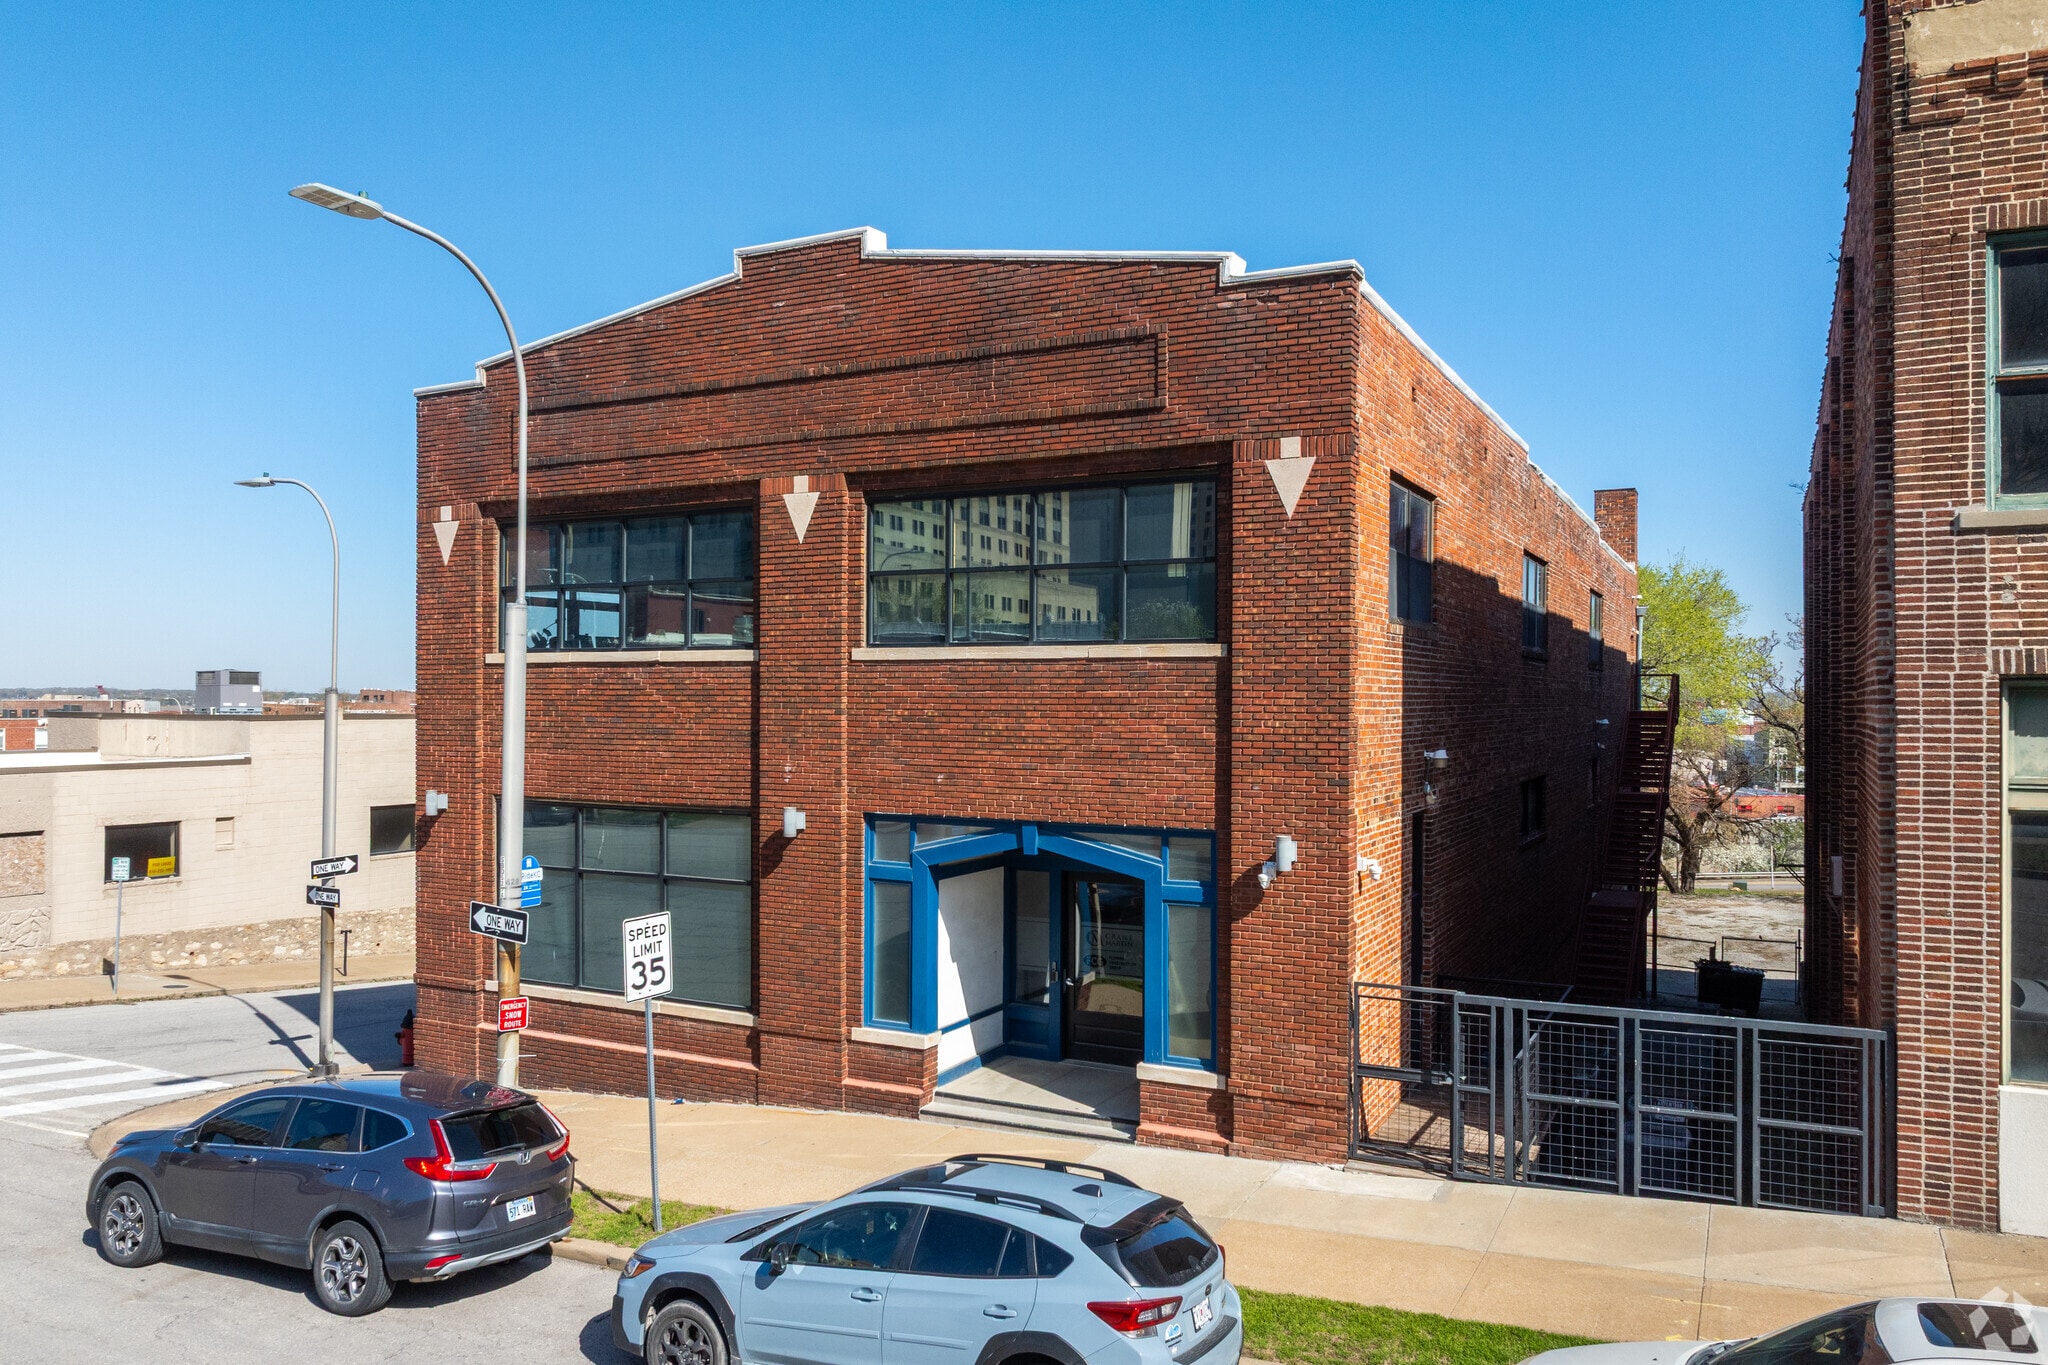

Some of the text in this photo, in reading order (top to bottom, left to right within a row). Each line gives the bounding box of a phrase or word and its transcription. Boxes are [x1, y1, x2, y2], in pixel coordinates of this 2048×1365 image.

[315, 862, 344, 874] ONE WAY
[326, 893, 336, 902] WAY
[487, 914, 521, 932] ONE WAY
[628, 924, 667, 942] SPEED
[633, 940, 663, 958] LIMIT
[631, 956, 666, 990] 35
[501, 1002, 526, 1010] EMERGENCY
[505, 1010, 522, 1019] SNOW
[504, 1020, 522, 1028] ROUTE
